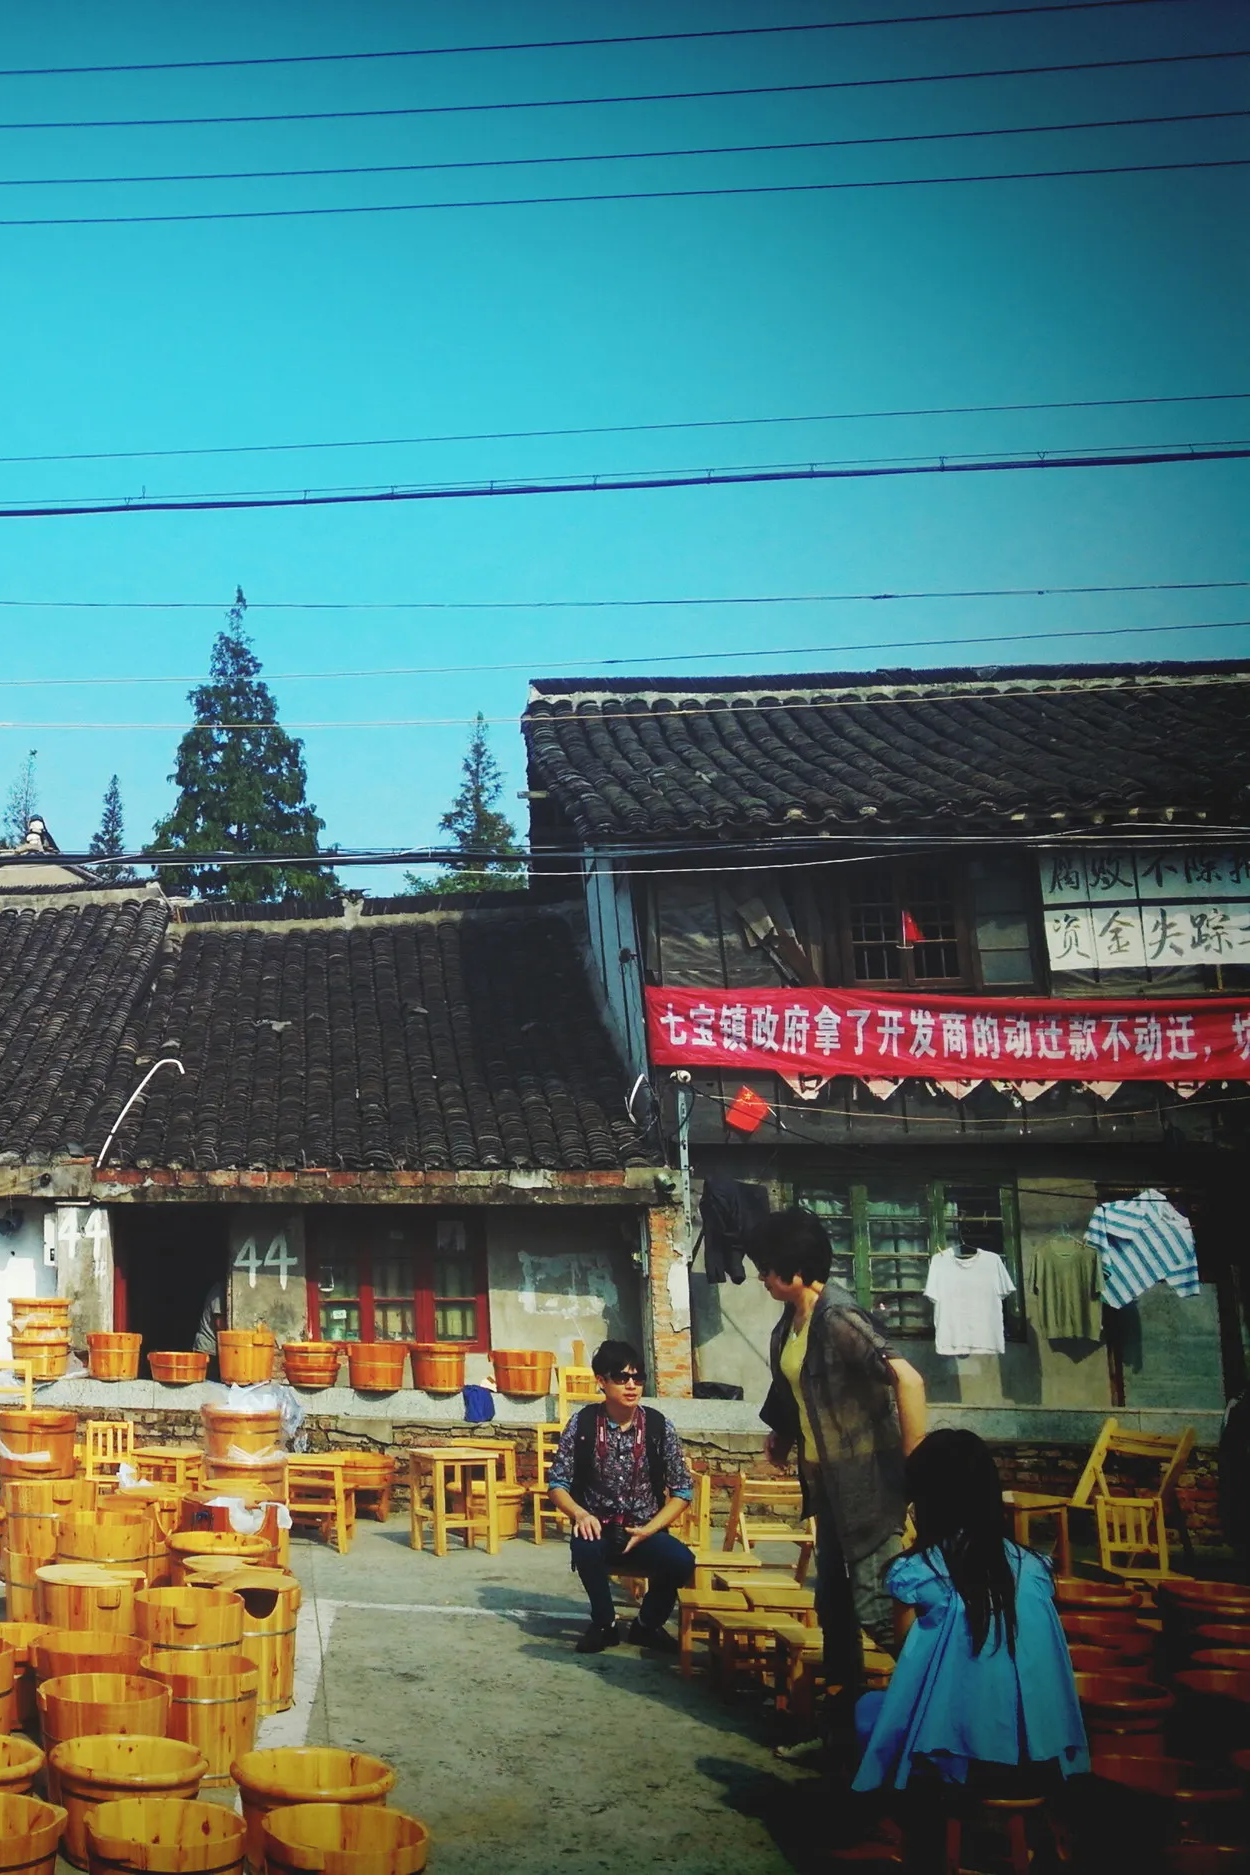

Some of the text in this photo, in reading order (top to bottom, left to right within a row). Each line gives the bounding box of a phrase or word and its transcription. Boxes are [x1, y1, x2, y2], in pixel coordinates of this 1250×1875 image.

[1054, 908, 1250, 959] 资金失踪
[233, 1232, 298, 1290] 44
